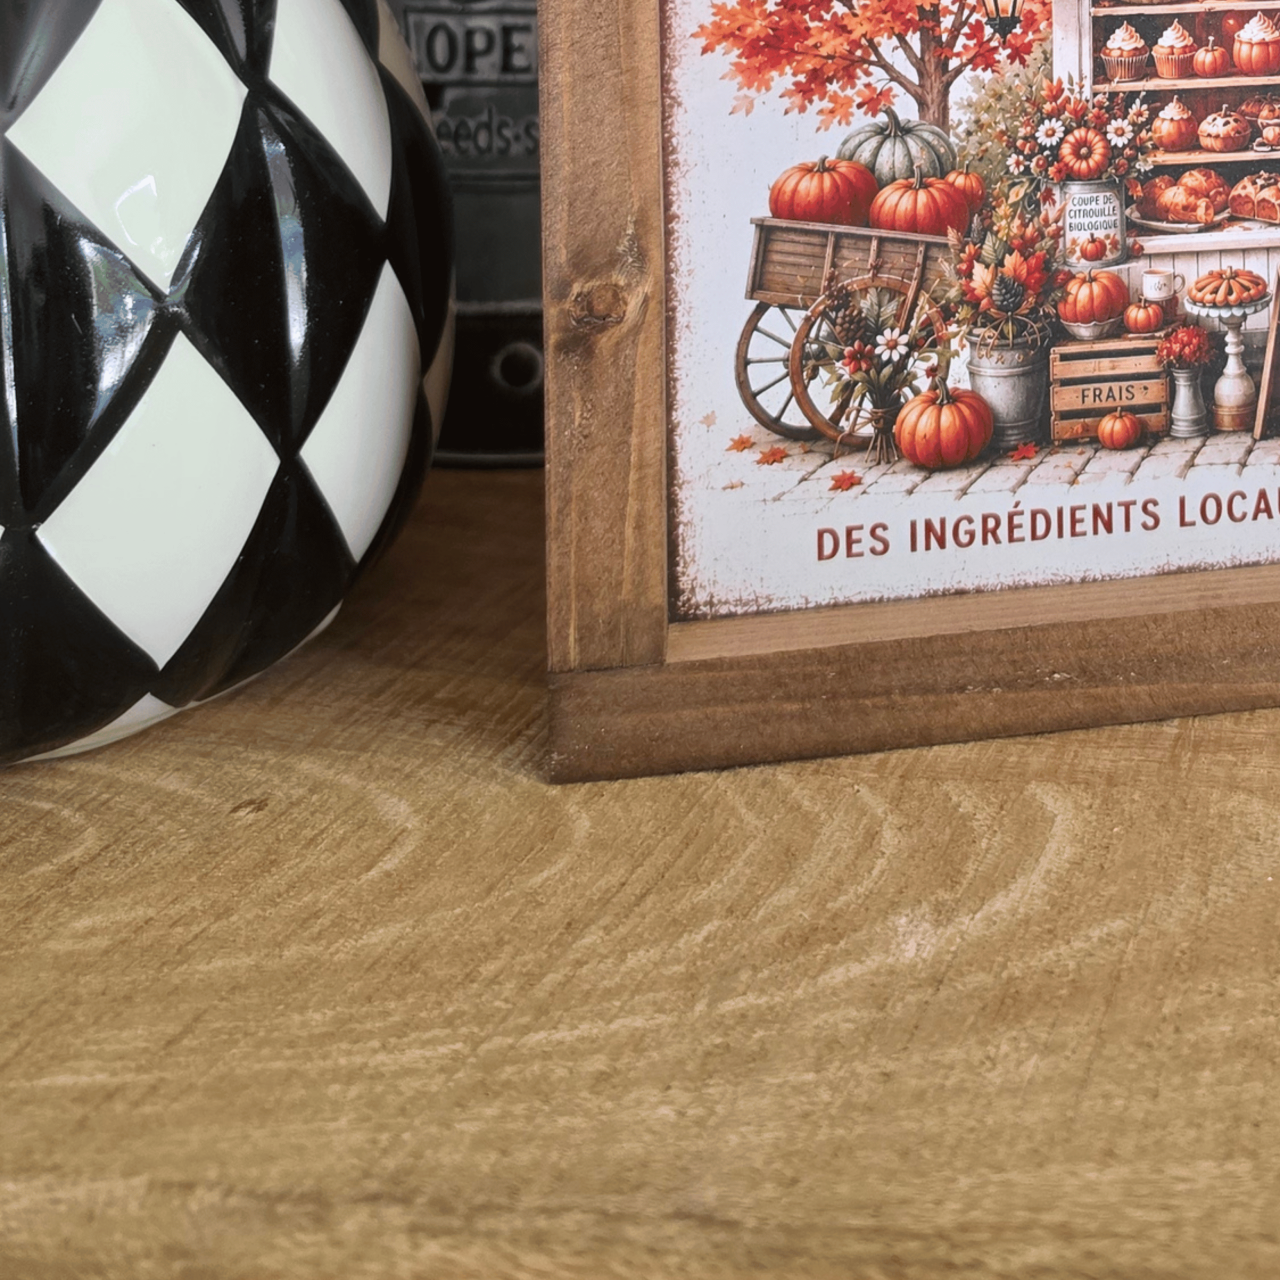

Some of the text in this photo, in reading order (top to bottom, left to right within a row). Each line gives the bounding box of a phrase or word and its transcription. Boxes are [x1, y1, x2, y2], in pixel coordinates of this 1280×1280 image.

[425, 22, 533, 75] OPE
[436, 106, 512, 155] eeds
[1071, 194, 1114, 207] COUPE DE
[1068, 205, 1118, 219] CITROUILLE
[1068, 219, 1118, 232] BIOLOGIQUE
[1081, 384, 1136, 405] FRAIS
[817, 522, 890, 561] DES
[909, 497, 1161, 553] INGRÉDIENTS
